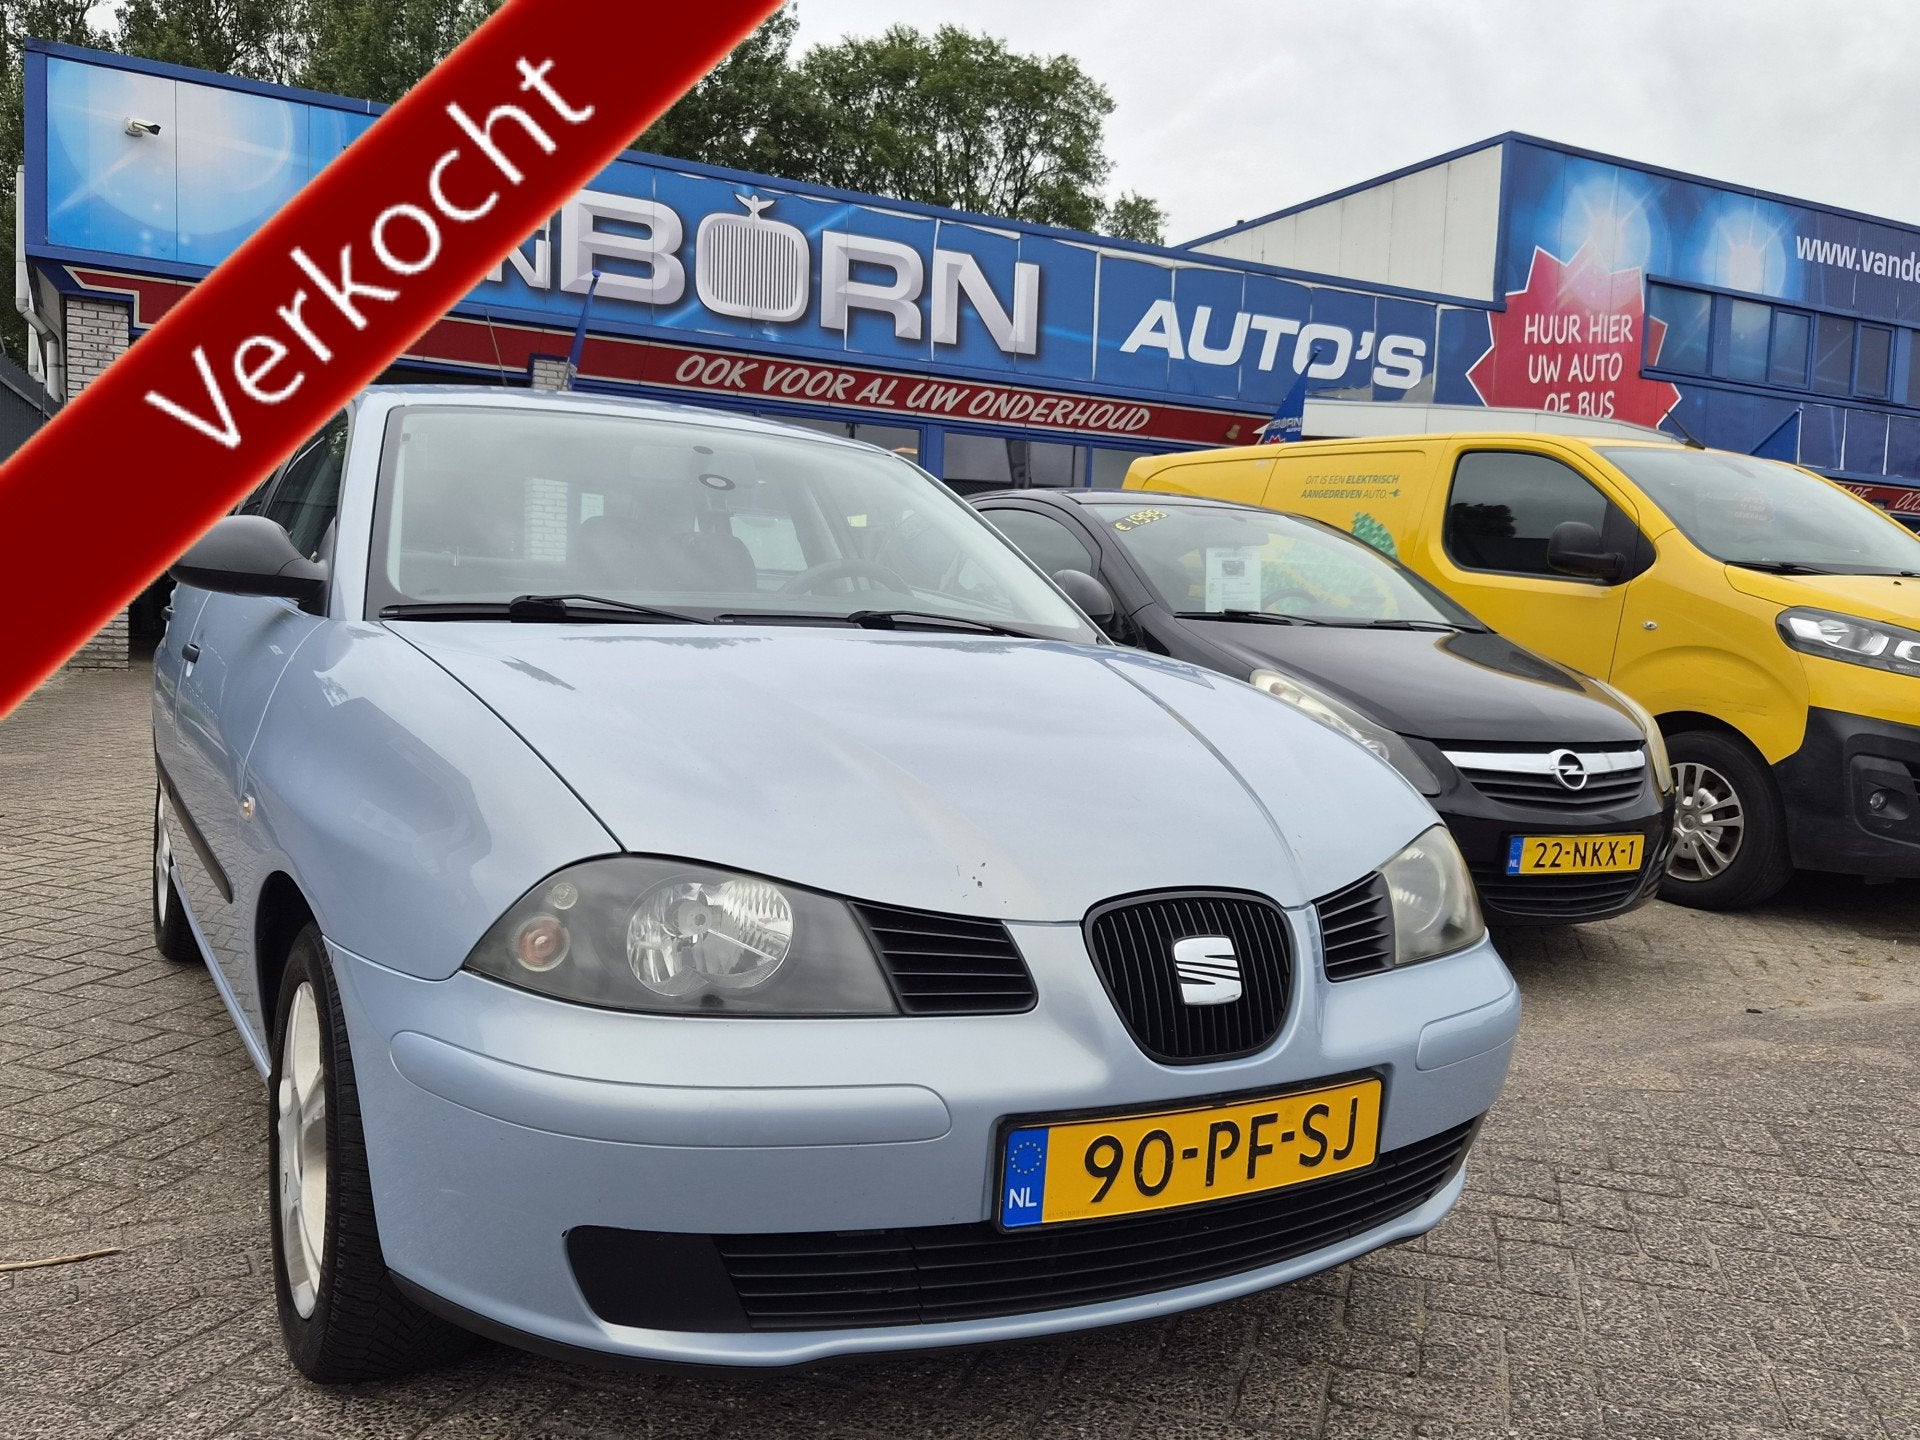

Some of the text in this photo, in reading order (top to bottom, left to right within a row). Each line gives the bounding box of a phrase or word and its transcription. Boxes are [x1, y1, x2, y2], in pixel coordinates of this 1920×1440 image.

[1119, 299, 1427, 390] AUTO'S
[1524, 313, 1633, 345] HUUR HIER
[1528, 352, 1623, 384] UW AUTO
[675, 354, 1151, 432] OOK VOOR AL UW ONDERHOUD
[1577, 390, 1616, 419] BUS
[1301, 489, 1362, 499] AANGEDREVEN
[1305, 474, 1400, 485] DIT IS EEN ELEKTRISCH
[1533, 840, 1635, 868] 22-NKX-1
[1008, 1097, 1359, 1209] NL 90-PF-SJ
